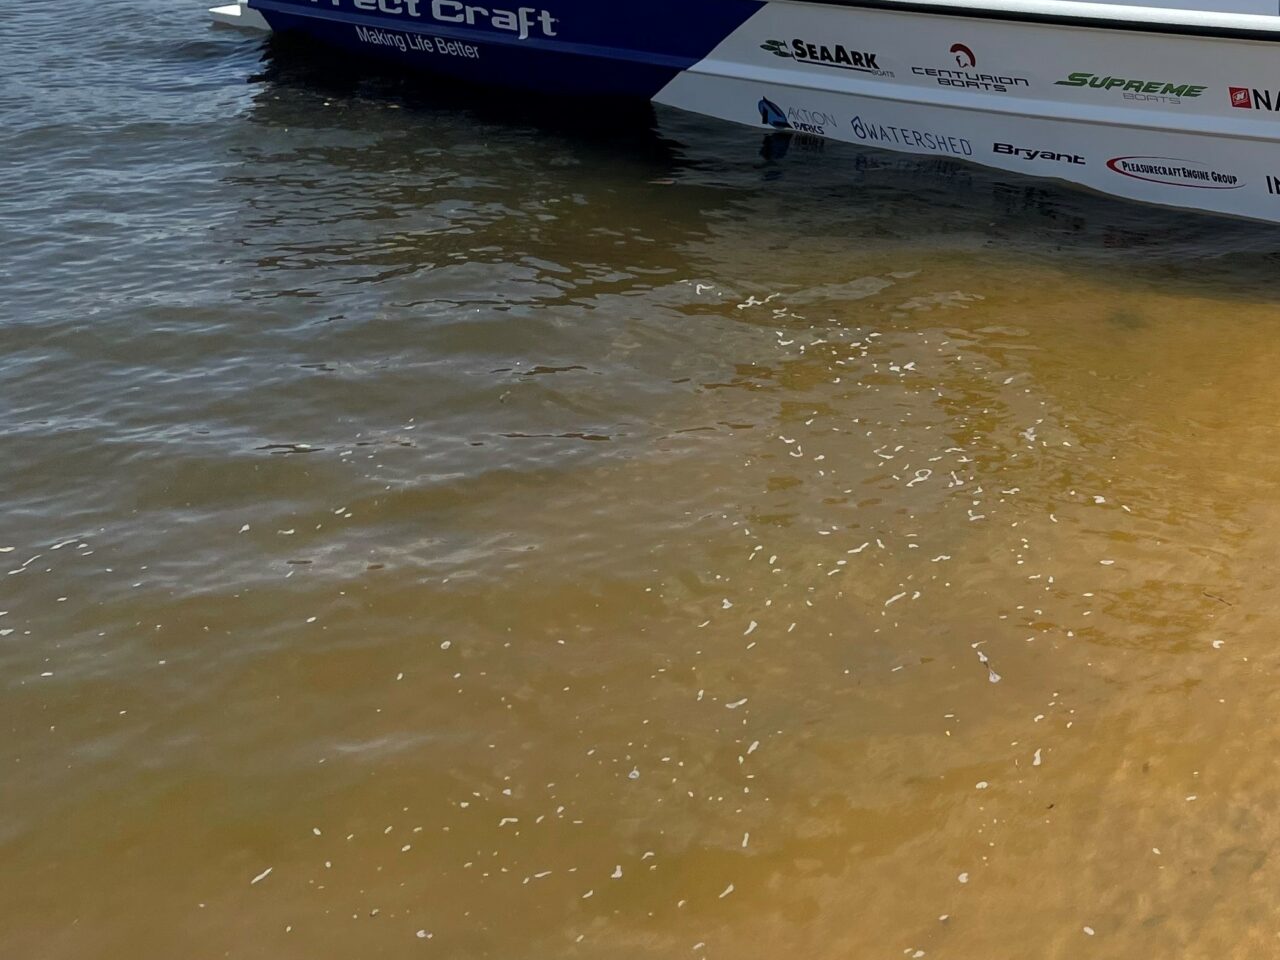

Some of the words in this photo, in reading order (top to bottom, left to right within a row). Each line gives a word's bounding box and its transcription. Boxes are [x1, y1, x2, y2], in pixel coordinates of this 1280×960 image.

[355, 25, 405, 52] Making
[409, 33, 433, 52] Life
[438, 37, 480, 59] Better
[871, 69, 895, 78] BOATS
[911, 66, 1030, 86] CENTURION
[937, 77, 1007, 92] BOATS
[1054, 72, 1208, 97] SUPREME
[1122, 92, 1181, 104] BOATS
[787, 106, 838, 127] AKTION
[792, 121, 825, 135] PARKS
[865, 122, 973, 156] WATERSHED
[992, 142, 1086, 165] Bryant
